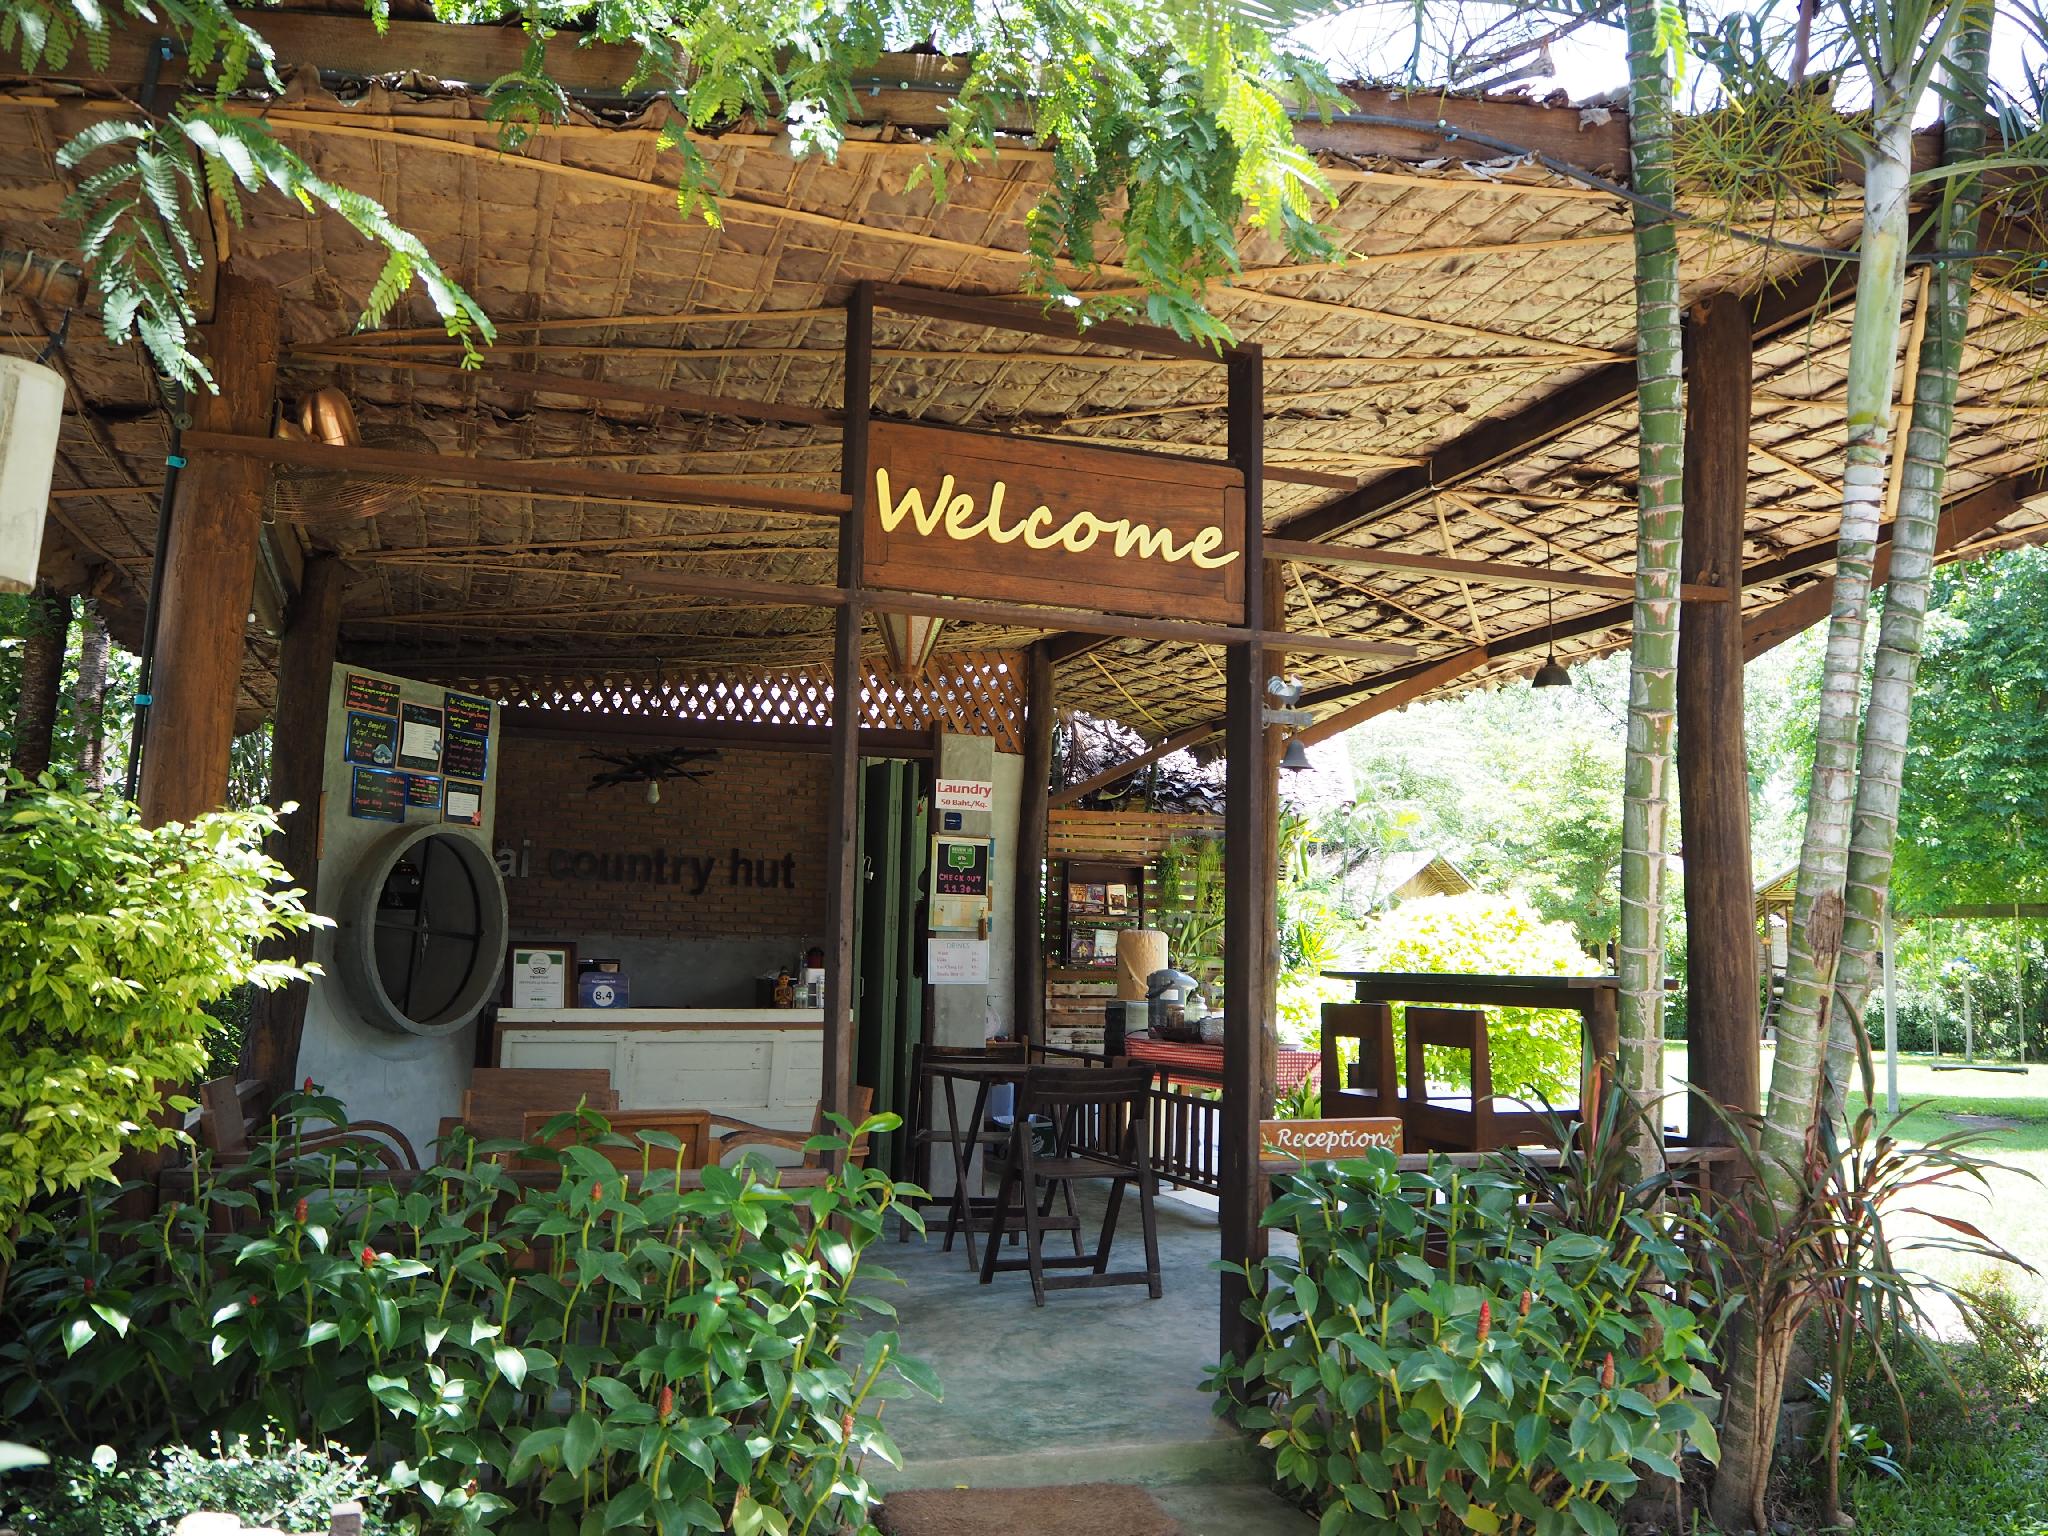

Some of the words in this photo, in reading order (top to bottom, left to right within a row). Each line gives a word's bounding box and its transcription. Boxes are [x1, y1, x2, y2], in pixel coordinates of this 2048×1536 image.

[876, 467, 1240, 569] Welcome
[937, 782, 992, 798] Laundry
[549, 848, 715, 896] country
[730, 848, 796, 889] hut
[939, 873, 964, 882] CHECK
[967, 875, 982, 883] OUT
[595, 991, 613, 1000] 8.4
[1277, 1128, 1391, 1153] Reception
